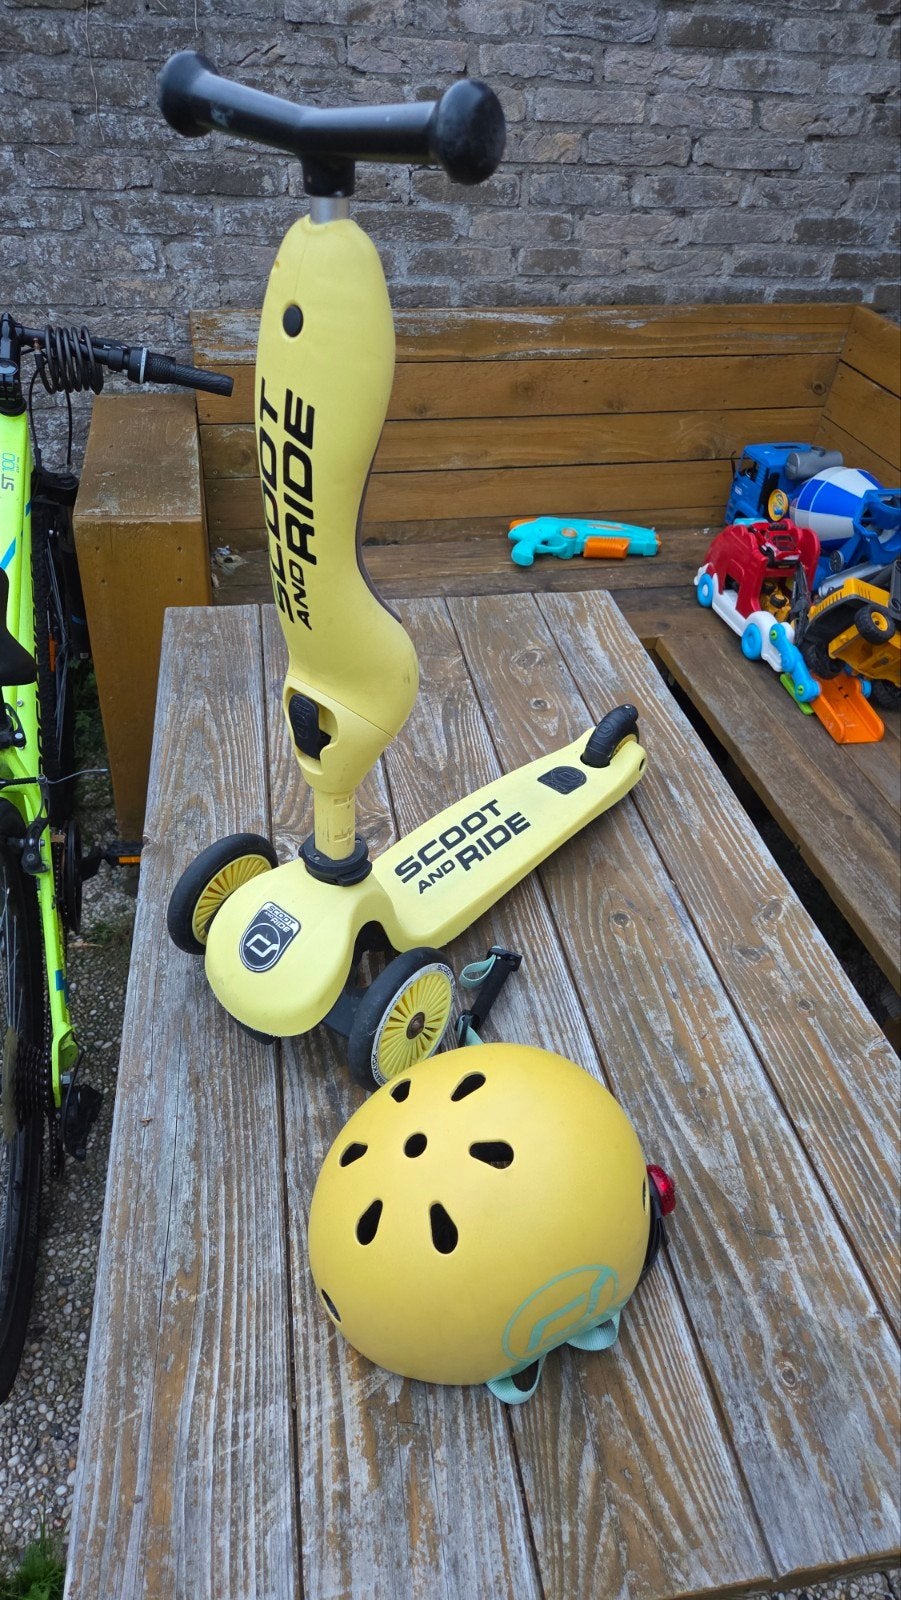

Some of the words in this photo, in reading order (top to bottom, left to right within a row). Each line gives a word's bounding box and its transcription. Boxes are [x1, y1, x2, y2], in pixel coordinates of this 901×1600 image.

[1, 473, 14, 491] ST
[283, 387, 317, 566] RIDE
[289, 558, 312, 631] AND
[394, 799, 501, 884] SCOOT
[418, 859, 456, 895] AND
[455, 811, 531, 872] RIDE
[267, 905, 295, 925] SCOOT
[270, 917, 292, 933] RIDE
